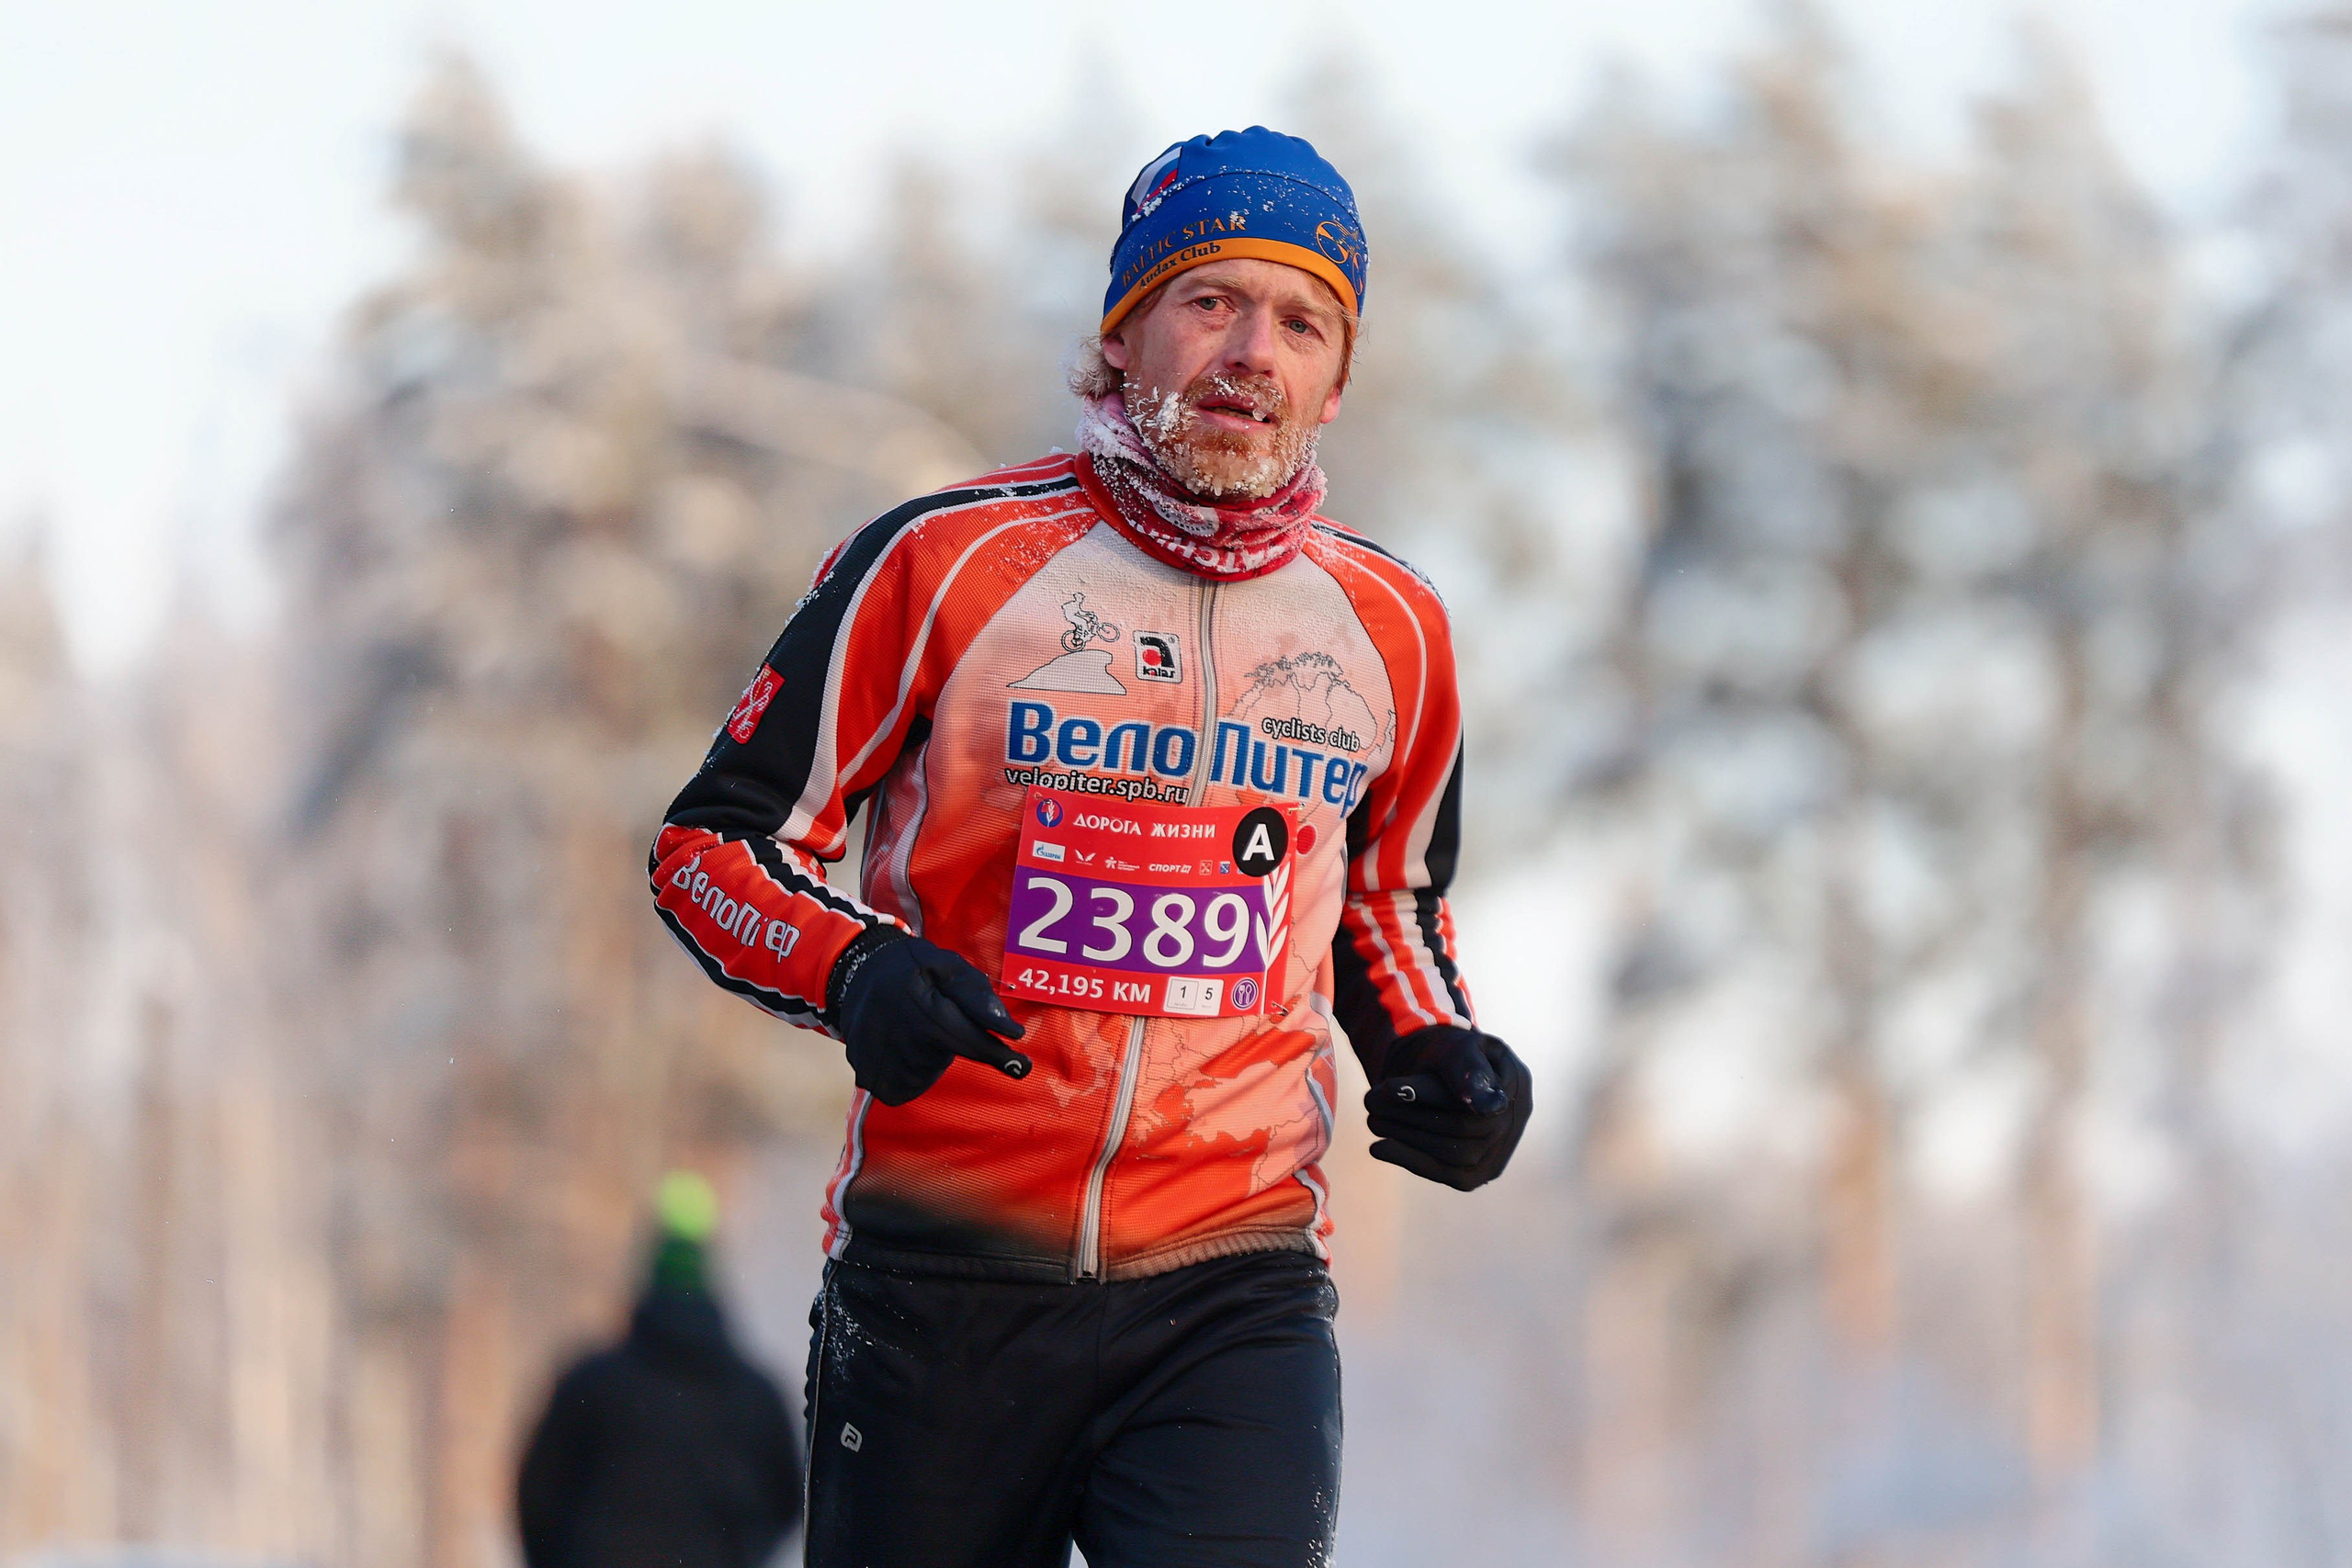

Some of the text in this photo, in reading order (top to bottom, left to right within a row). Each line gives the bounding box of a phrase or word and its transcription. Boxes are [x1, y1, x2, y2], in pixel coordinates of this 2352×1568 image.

[1123, 214, 1248, 288] BALTIC STAR
[1139, 242, 1222, 290] Audax Club
[1261, 716, 1362, 752] cyclists club
[1005, 766, 1191, 805] velopiter.spb.ru
[1072, 813, 1217, 839] ДОРОГА ЖИЗНИ
[1018, 876, 1250, 968] 2389
[1017, 967, 1152, 1004] 42,195 КМ
[1180, 985, 1214, 1000] 1 5
